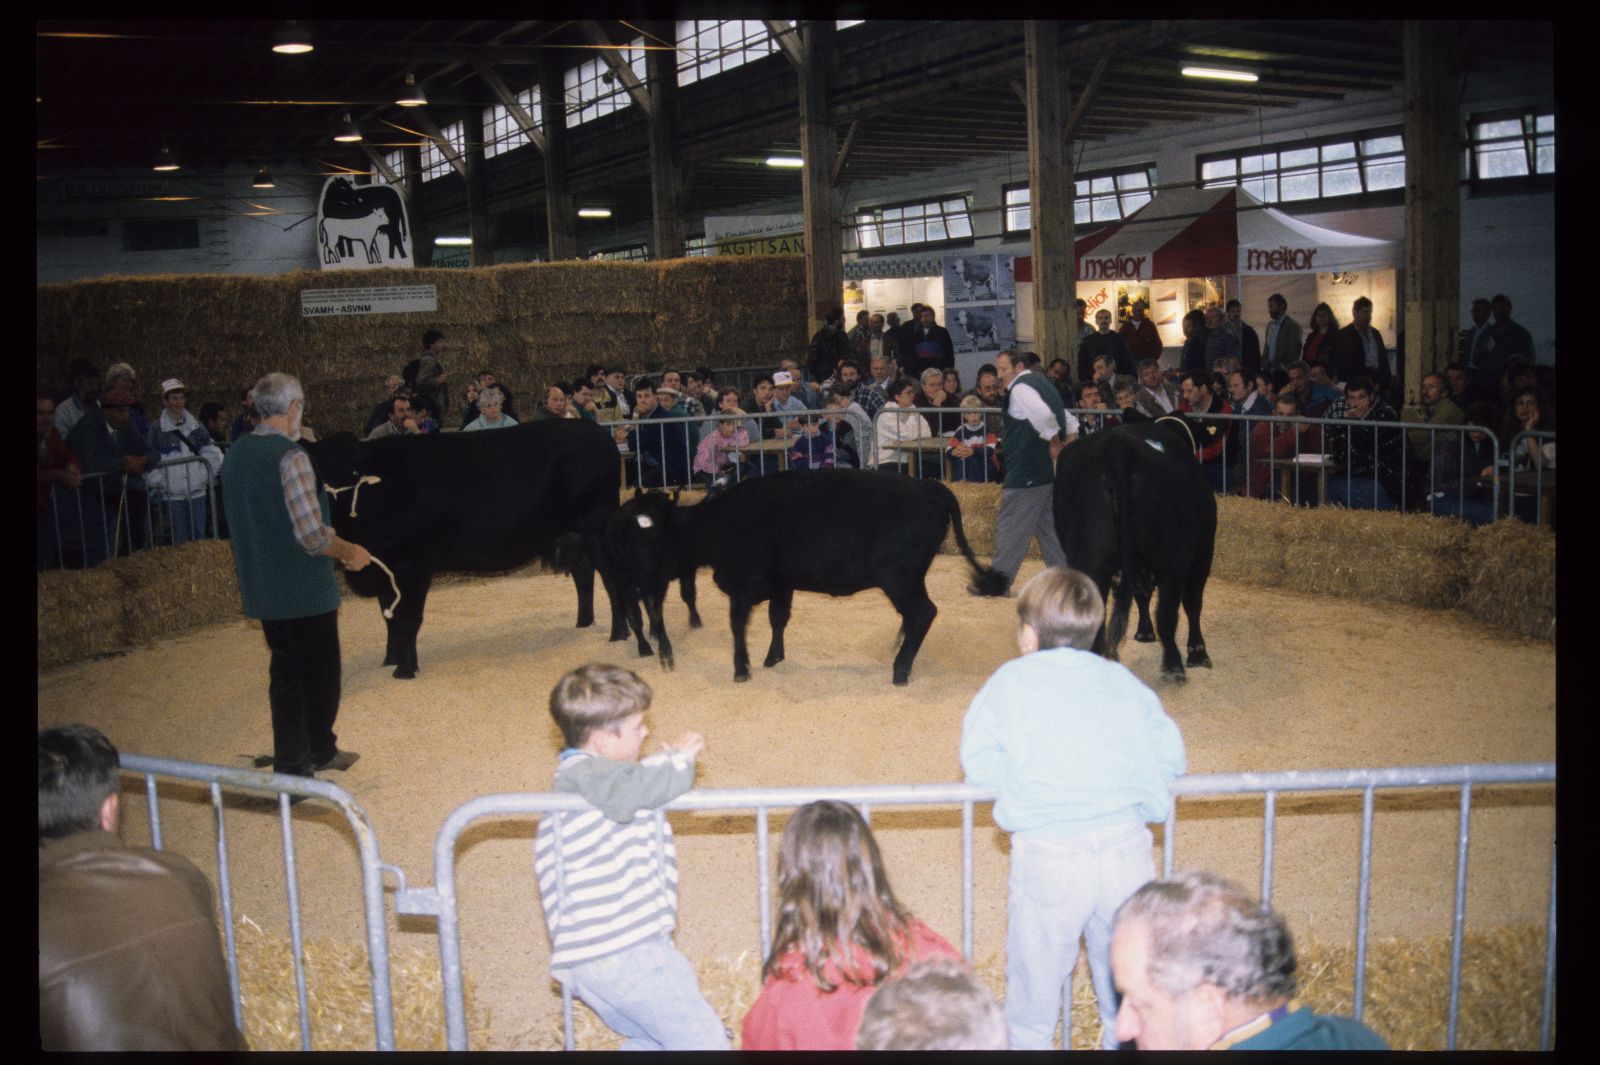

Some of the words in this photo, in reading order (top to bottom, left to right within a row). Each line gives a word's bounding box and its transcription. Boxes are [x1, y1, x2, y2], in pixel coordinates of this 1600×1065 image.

[1084, 252, 1147, 279] melior
[1247, 244, 1318, 271] melior
[303, 305, 334, 315] SVAMH
